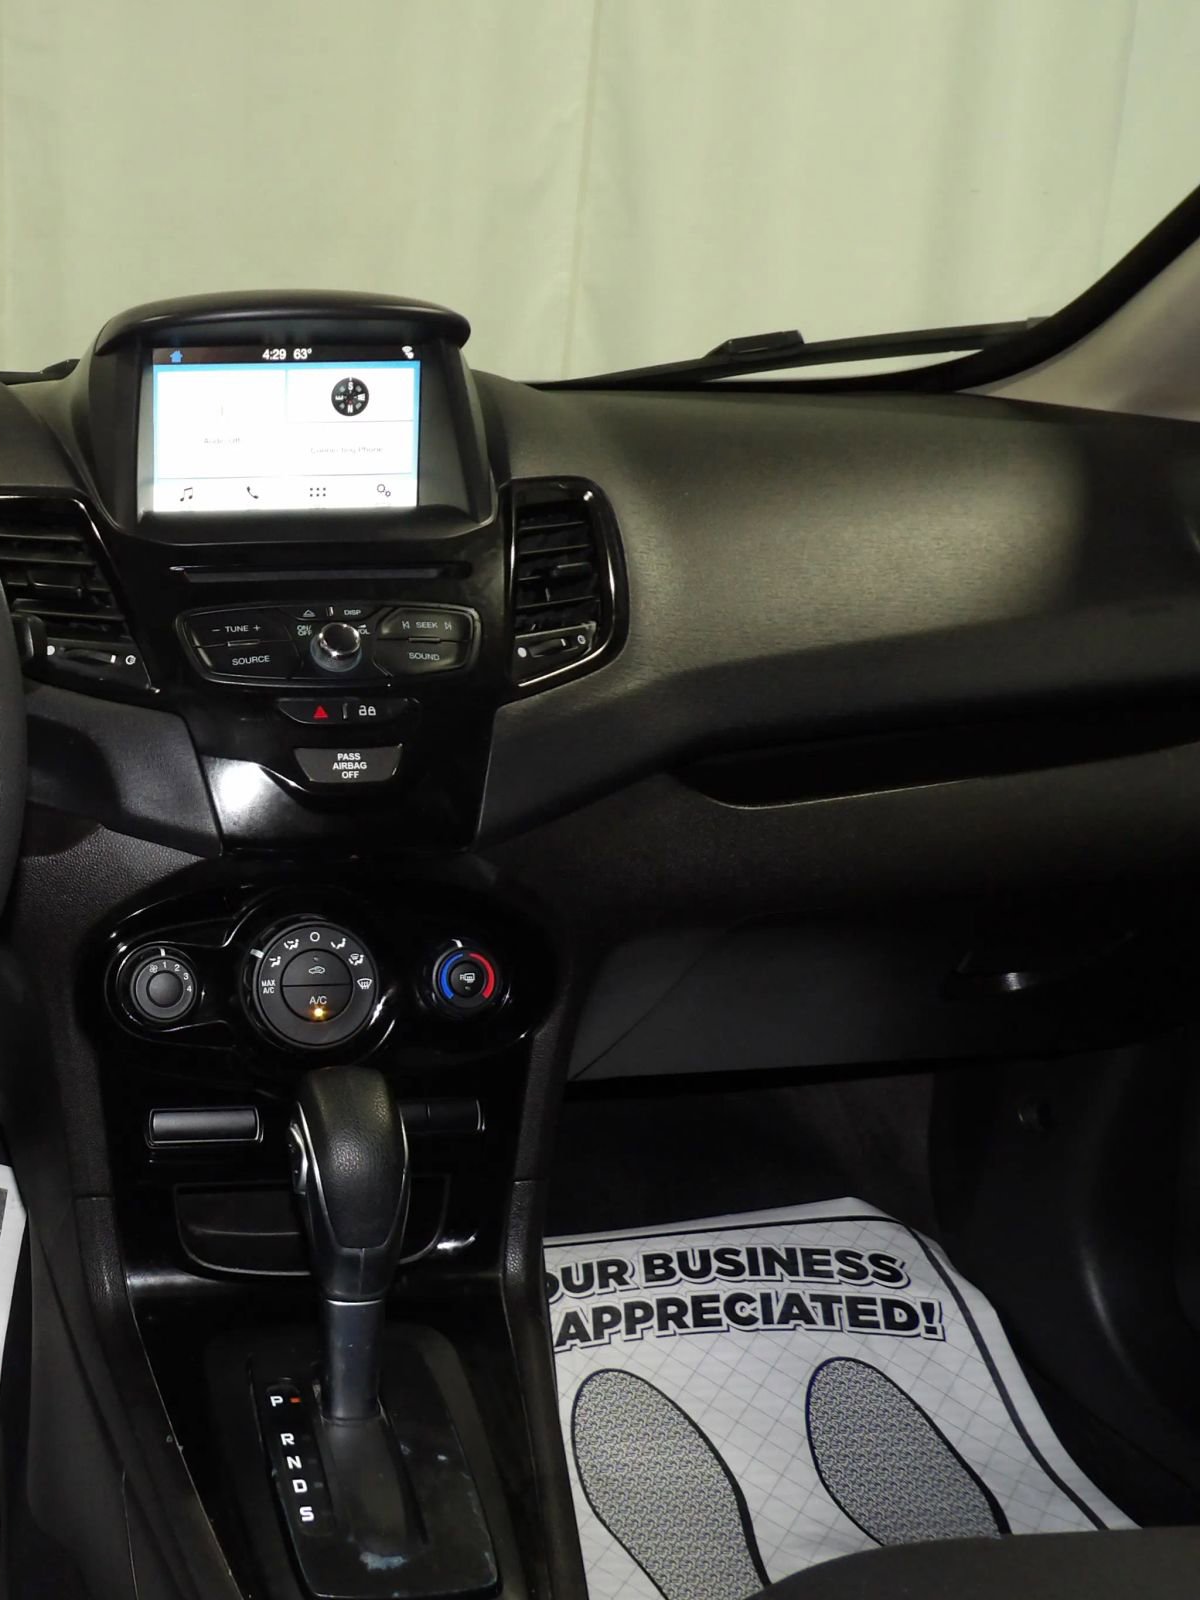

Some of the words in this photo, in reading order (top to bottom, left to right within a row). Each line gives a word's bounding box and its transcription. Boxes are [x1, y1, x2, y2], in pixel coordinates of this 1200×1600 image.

[262, 348, 287, 360] 4:29
[232, 655, 270, 666] SOURCE
[408, 652, 440, 660] SOUND
[337, 752, 361, 761] PASS
[332, 762, 368, 770] AIRBAG
[341, 770, 360, 778] OFF
[174, 964, 180, 972] 2
[309, 995, 328, 1005] A/C
[642, 1246, 906, 1286] BUSINESS
[555, 1291, 942, 1348] APPRECIATED!
[270, 1396, 284, 1407] P
[280, 1432, 295, 1446] R
[286, 1455, 302, 1469] N
[292, 1479, 308, 1493] D
[300, 1506, 315, 1522] S
